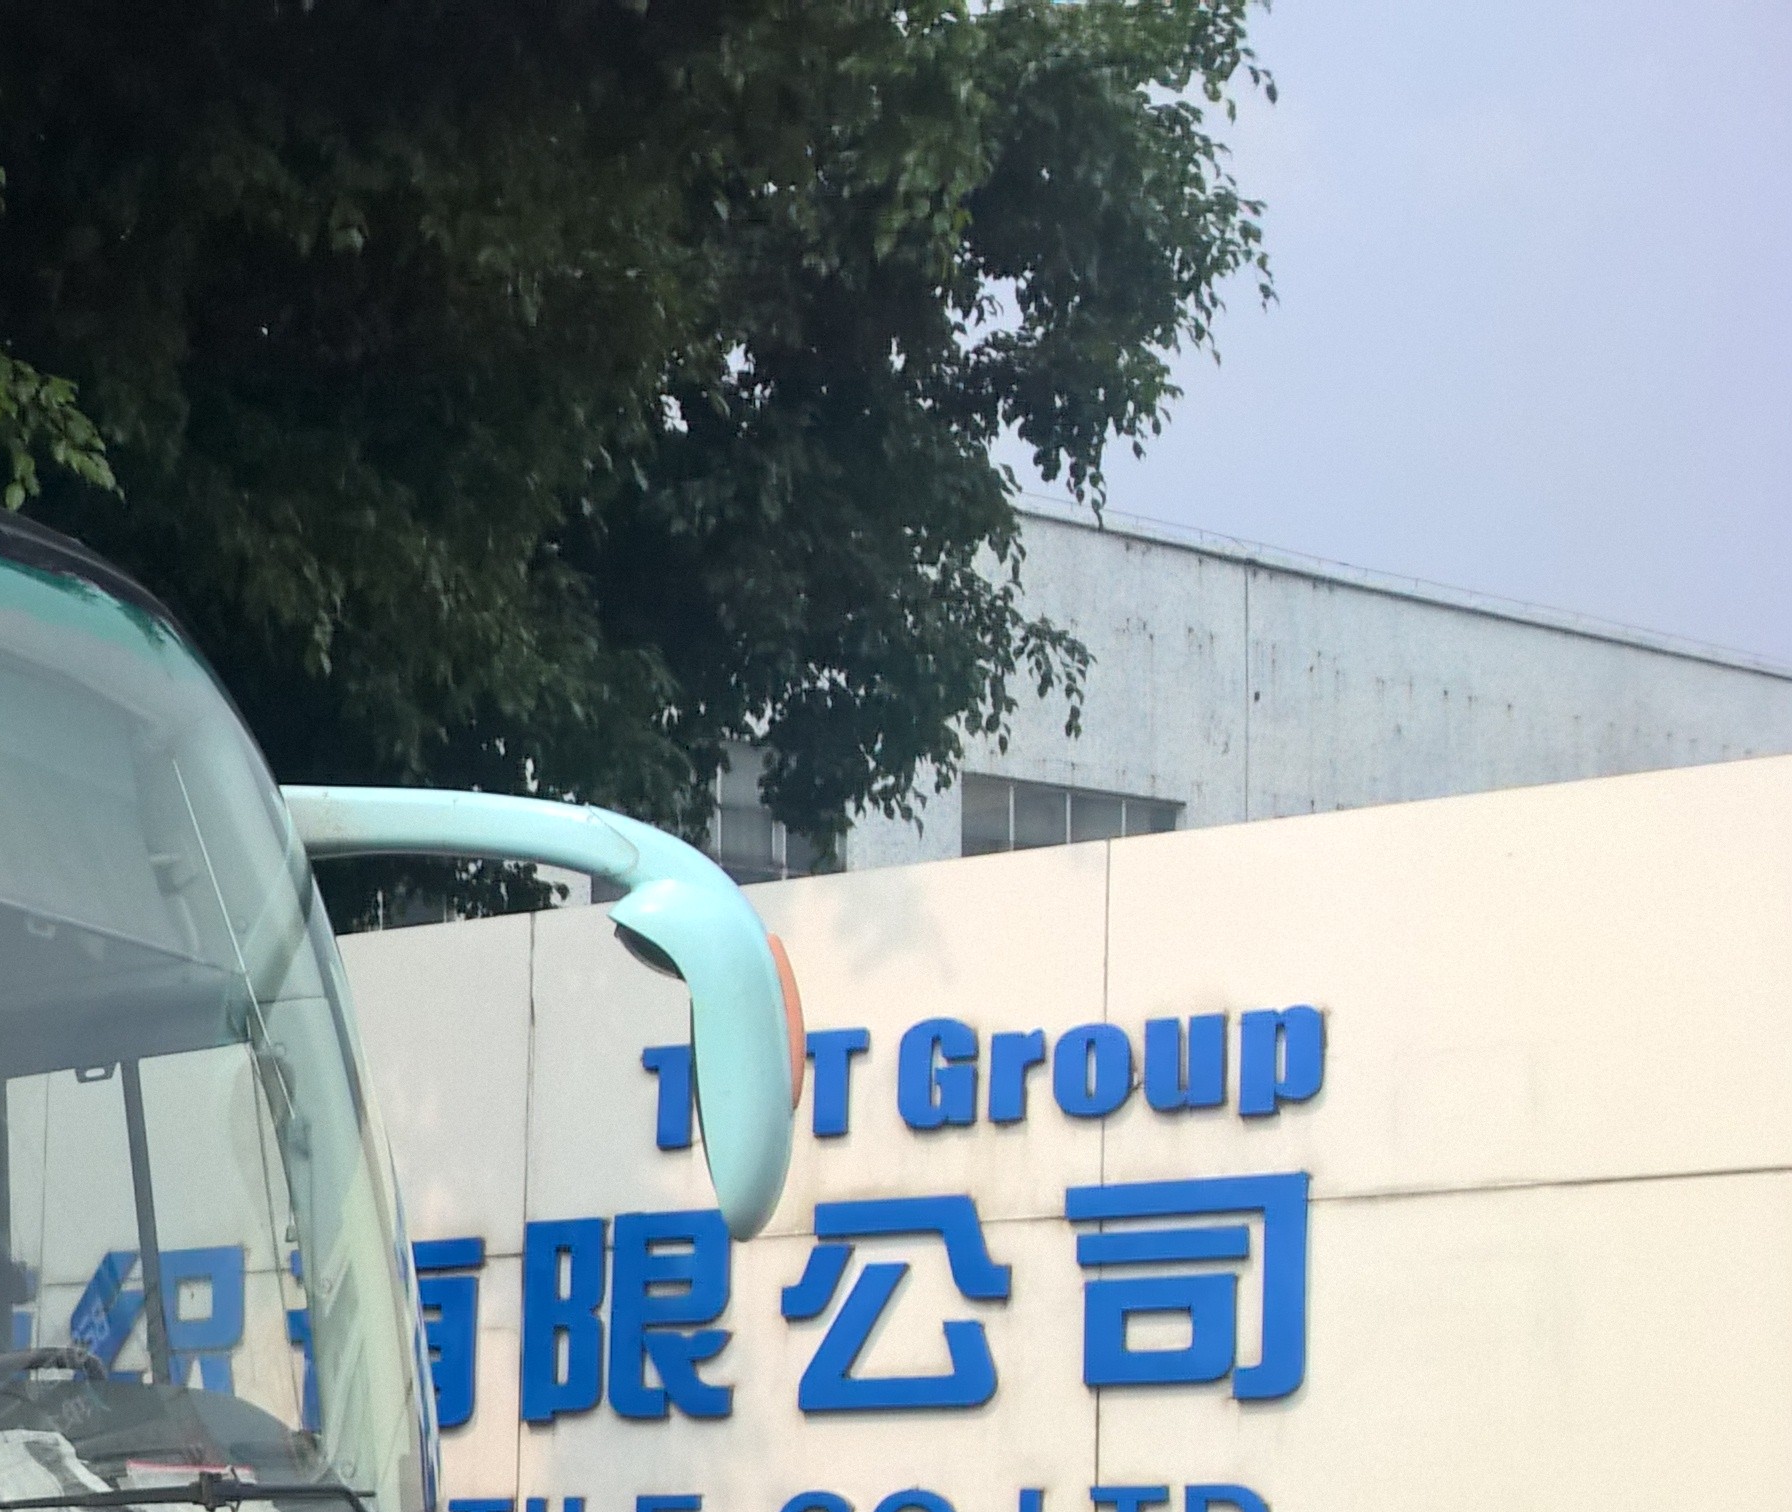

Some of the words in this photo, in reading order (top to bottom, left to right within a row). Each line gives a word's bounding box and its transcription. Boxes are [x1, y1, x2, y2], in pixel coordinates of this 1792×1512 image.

[641, 1028, 871, 1152] TT
[897, 1004, 1327, 1132] Group
[13, 1172, 1310, 1427] 织有限公司
